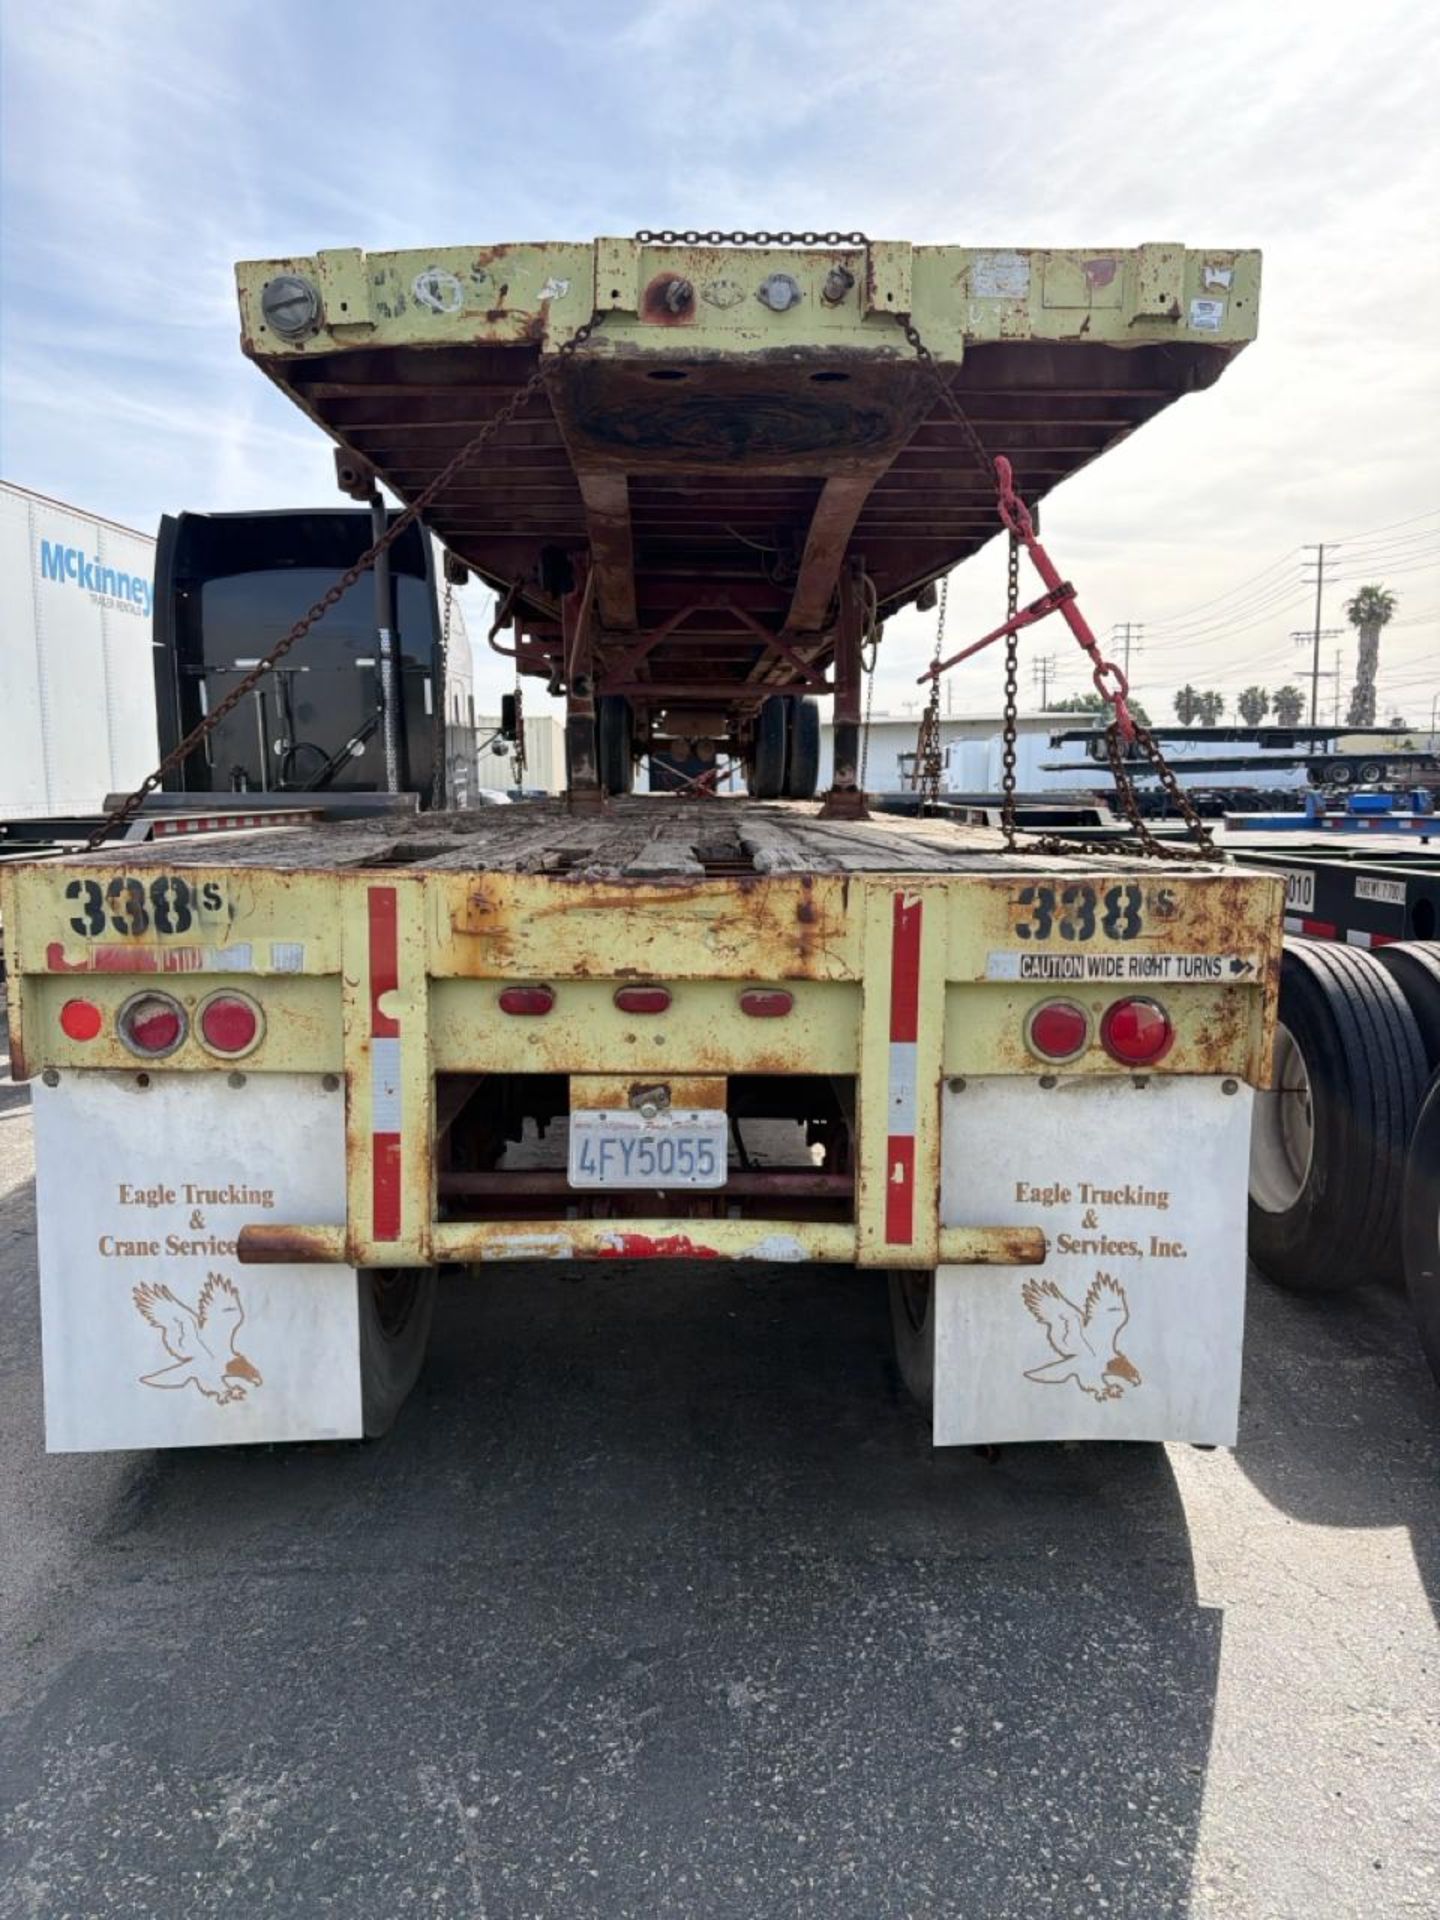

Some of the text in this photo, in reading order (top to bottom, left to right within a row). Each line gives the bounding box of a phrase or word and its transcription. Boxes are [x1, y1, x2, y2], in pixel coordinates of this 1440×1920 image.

[1284, 874, 1312, 906] 010
[65, 876, 193, 937] 338
[1015, 884, 1143, 941] 338
[1020, 954, 1222, 979] CAUTION WIDE RIGHT TURNS
[579, 1137, 716, 1176] 4FY5055
[118, 1183, 276, 1209] Eagle Trucking
[1015, 1181, 1170, 1210] Eagle Trucking
[189, 1208, 206, 1230] &
[1081, 1208, 1098, 1230] &
[98, 1233, 239, 1257] Crane Service
[1057, 1233, 1144, 1261] Services,
[1149, 1235, 1188, 1258] Inc.
